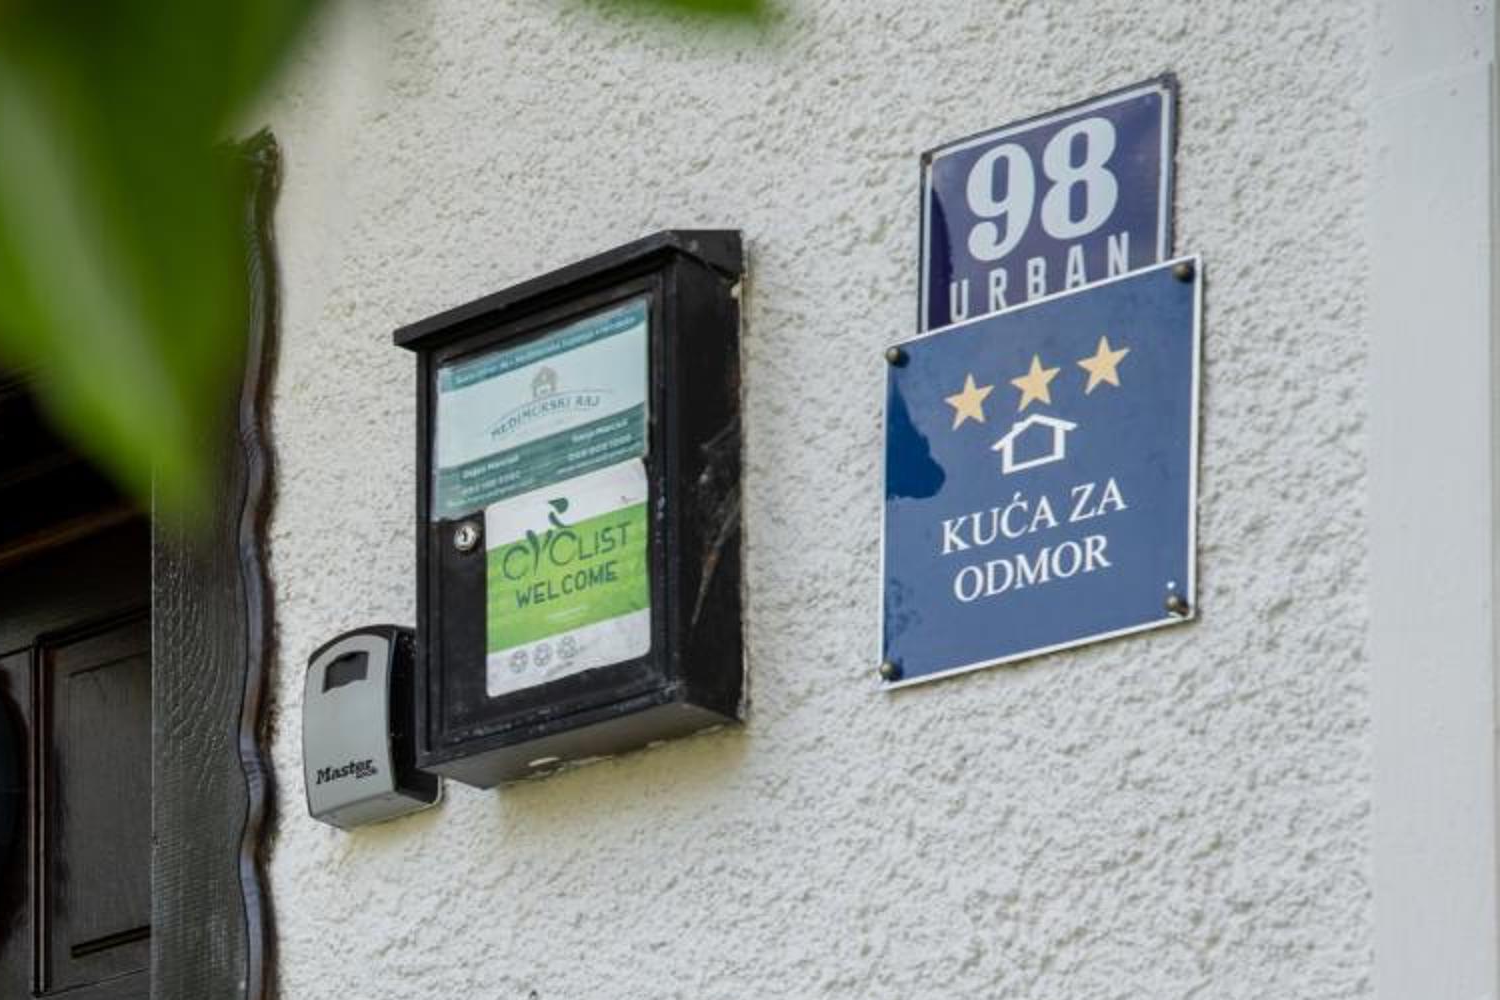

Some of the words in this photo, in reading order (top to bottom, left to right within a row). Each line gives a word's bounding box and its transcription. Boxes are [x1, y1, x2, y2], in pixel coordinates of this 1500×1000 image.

[966, 116, 1119, 262] 98
[949, 231, 1130, 323] URBAN
[502, 520, 633, 581] CYCLIST
[941, 490, 1059, 556] KUĆA
[1069, 477, 1128, 524] ZA
[515, 560, 620, 609] WELCOME
[953, 533, 1112, 603] ODMOR
[315, 759, 374, 785] Master
